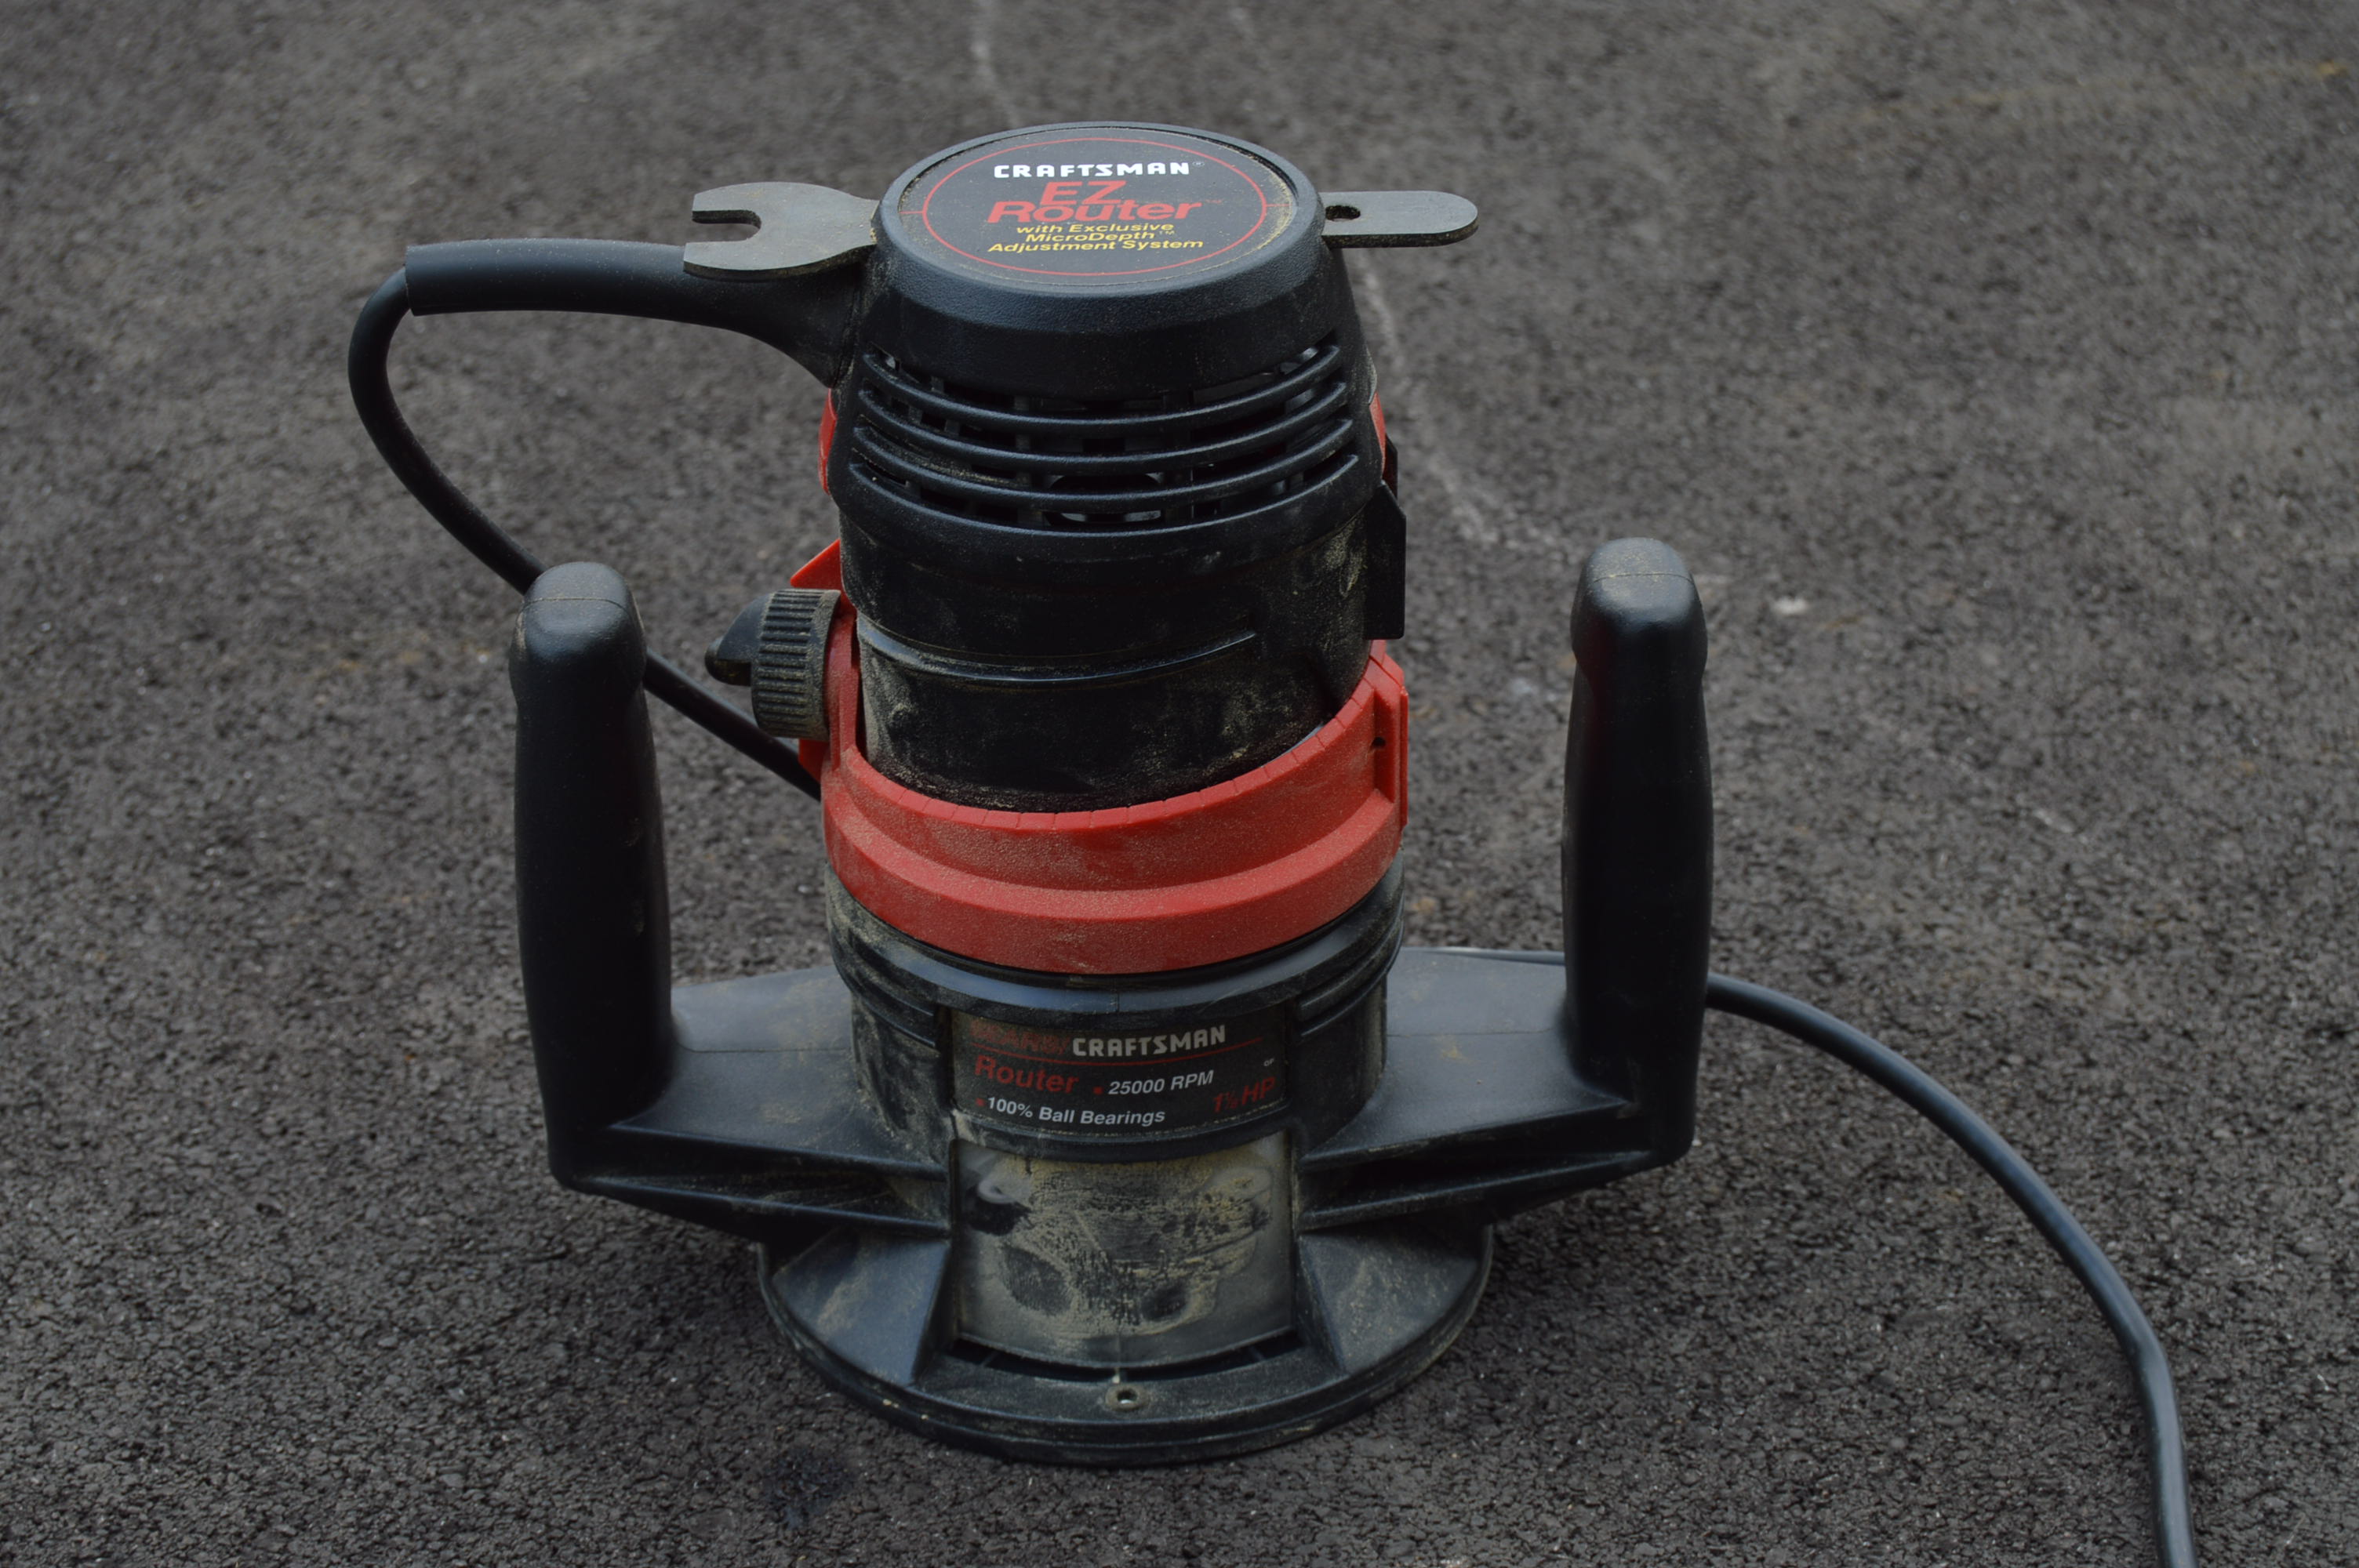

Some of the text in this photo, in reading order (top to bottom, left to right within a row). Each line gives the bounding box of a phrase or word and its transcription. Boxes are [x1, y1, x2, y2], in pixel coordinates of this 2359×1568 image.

[994, 162, 1190, 178] CRAFTSMAN
[1040, 180, 1127, 205] EZ
[987, 199, 1203, 223] Router
[1016, 223, 1174, 234] with Exclusive
[1026, 231, 1155, 243] MicroDepth
[987, 239, 1204, 253] Adjustment System
[1073, 1025, 1226, 1057] CRAFTSMAN
[974, 1054, 1215, 1095] Router 25000 RPM
[1242, 1076, 1277, 1106] HP
[987, 1097, 1166, 1127] 100% Ball Bearings
